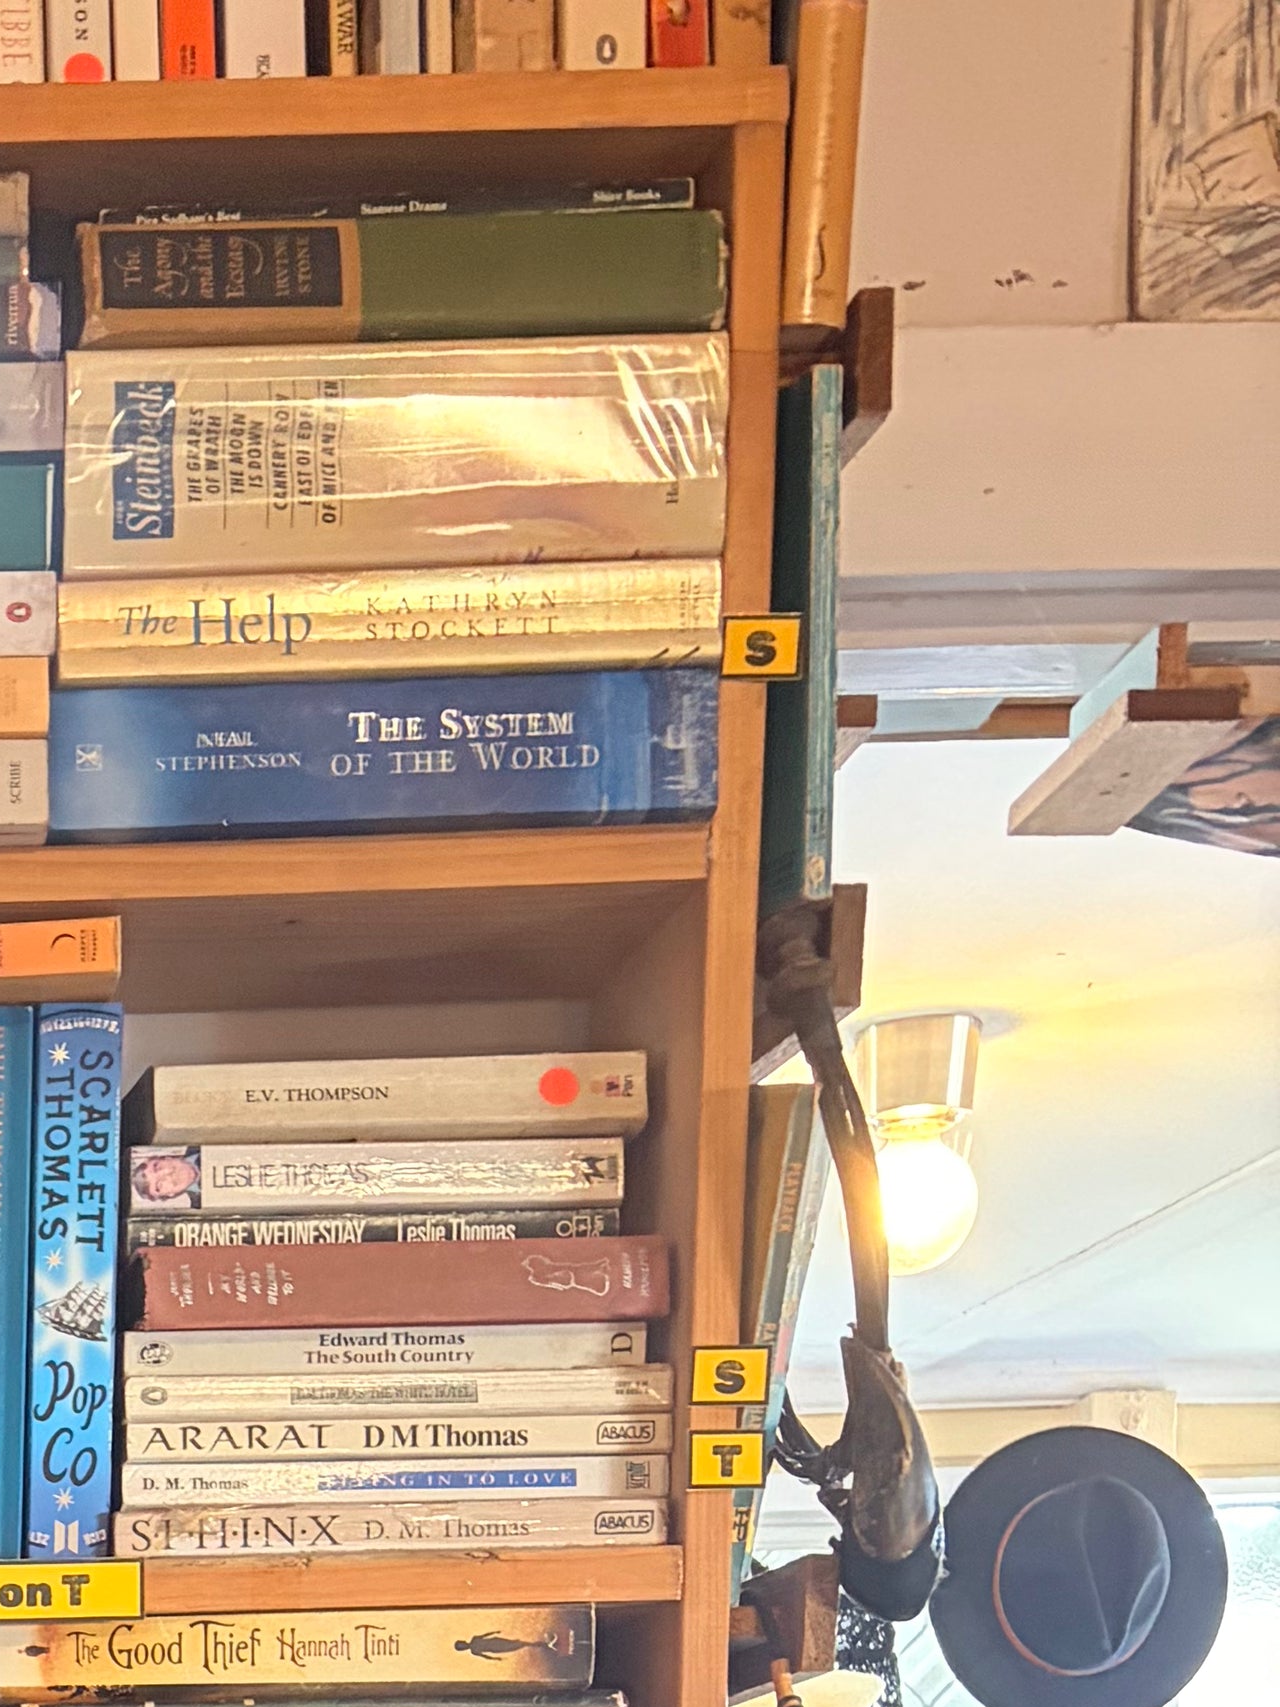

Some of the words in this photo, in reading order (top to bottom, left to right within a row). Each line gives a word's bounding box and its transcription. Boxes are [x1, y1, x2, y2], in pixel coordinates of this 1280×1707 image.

[119, 605, 178, 636] The
[189, 594, 312, 654] Help
[744, 631, 778, 666] S
[245, 1089, 276, 1103] E.V.
[284, 1086, 389, 1103] THOMPSON
[38, 1069, 76, 1241] THOMAS
[74, 1048, 112, 1253] SCARLETT
[318, 1331, 386, 1348] Edward
[391, 1331, 465, 1347] Thomas
[34, 1358, 104, 1422] Pop
[715, 1362, 746, 1393] S
[43, 1428, 98, 1486] Co
[712, 1444, 740, 1478] T
[62, 1575, 90, 1606] T
[66, 1632, 99, 1662] The
[108, 1626, 183, 1666] Good
[192, 1621, 262, 1669] Thief
[278, 1629, 351, 1661] Hannah
[356, 1624, 401, 1659] Tinti
